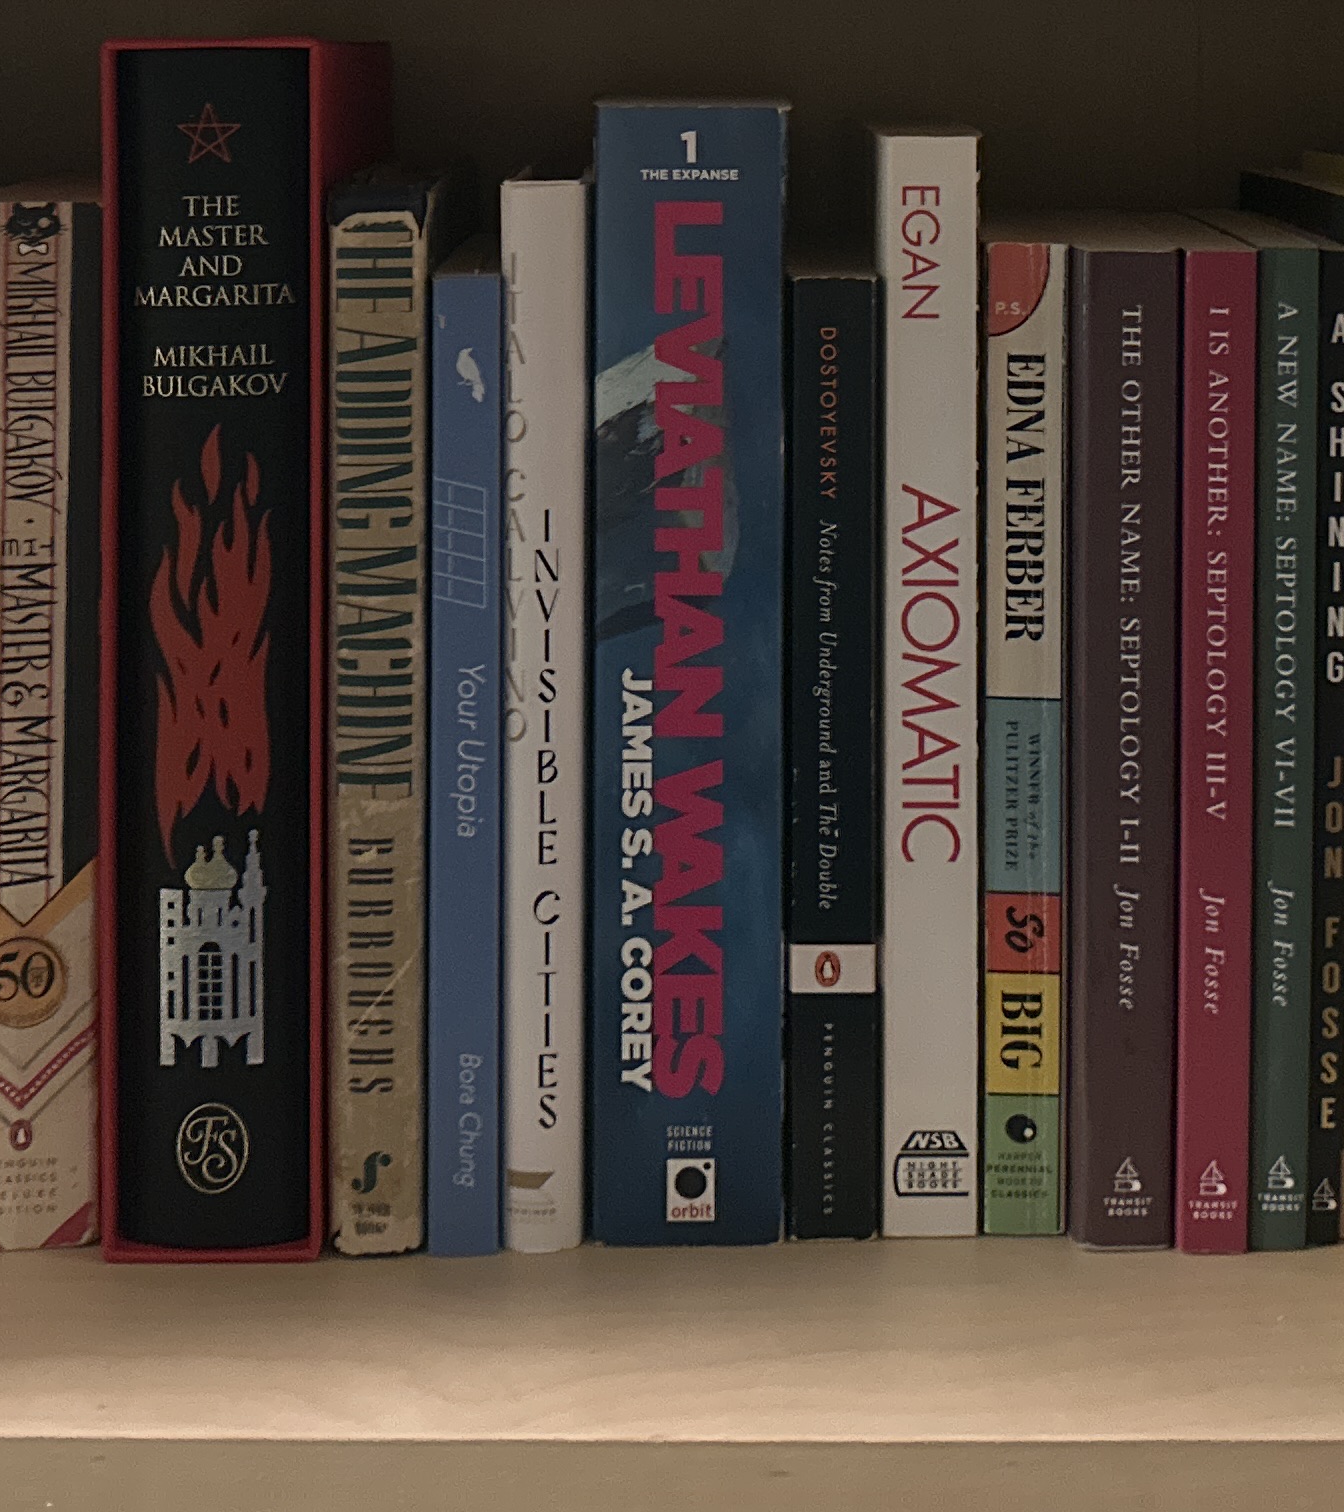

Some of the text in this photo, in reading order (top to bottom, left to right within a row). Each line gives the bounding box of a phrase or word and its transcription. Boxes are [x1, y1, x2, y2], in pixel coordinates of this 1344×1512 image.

[181, 195, 240, 215] THE
[640, 168, 739, 182] THE EXPANSE
[678, 131, 696, 163] 1
[132, 284, 295, 306] MARGARITA
[159, 225, 269, 246] MASTER
[179, 255, 243, 276] AND
[900, 185, 940, 320] EGAN
[141, 373, 287, 397] BULGAKOV
[154, 345, 274, 366] MIKHAIL
[816, 327, 837, 500] DOSTOYEVSKY
[1002, 352, 1045, 642] EDNA FERBER
[1205, 306, 1230, 819] I IS ANOTHER: SEPTOLOGY III-V
[654, 200, 722, 1099] LEVIATHAN WAKES
[811, 519, 839, 909] Notes from Underground and The Double
[899, 484, 960, 864] AXIOMATIC
[451, 663, 483, 838] Your Utopia
[618, 668, 655, 1091] JAMES S. A. COREY
[999, 905, 1045, 1071] So BIG
[1198, 888, 1227, 1014] Jon Fosse
[452, 1053, 482, 1187] Bora Chung
[669, 1203, 714, 1219] orbit
